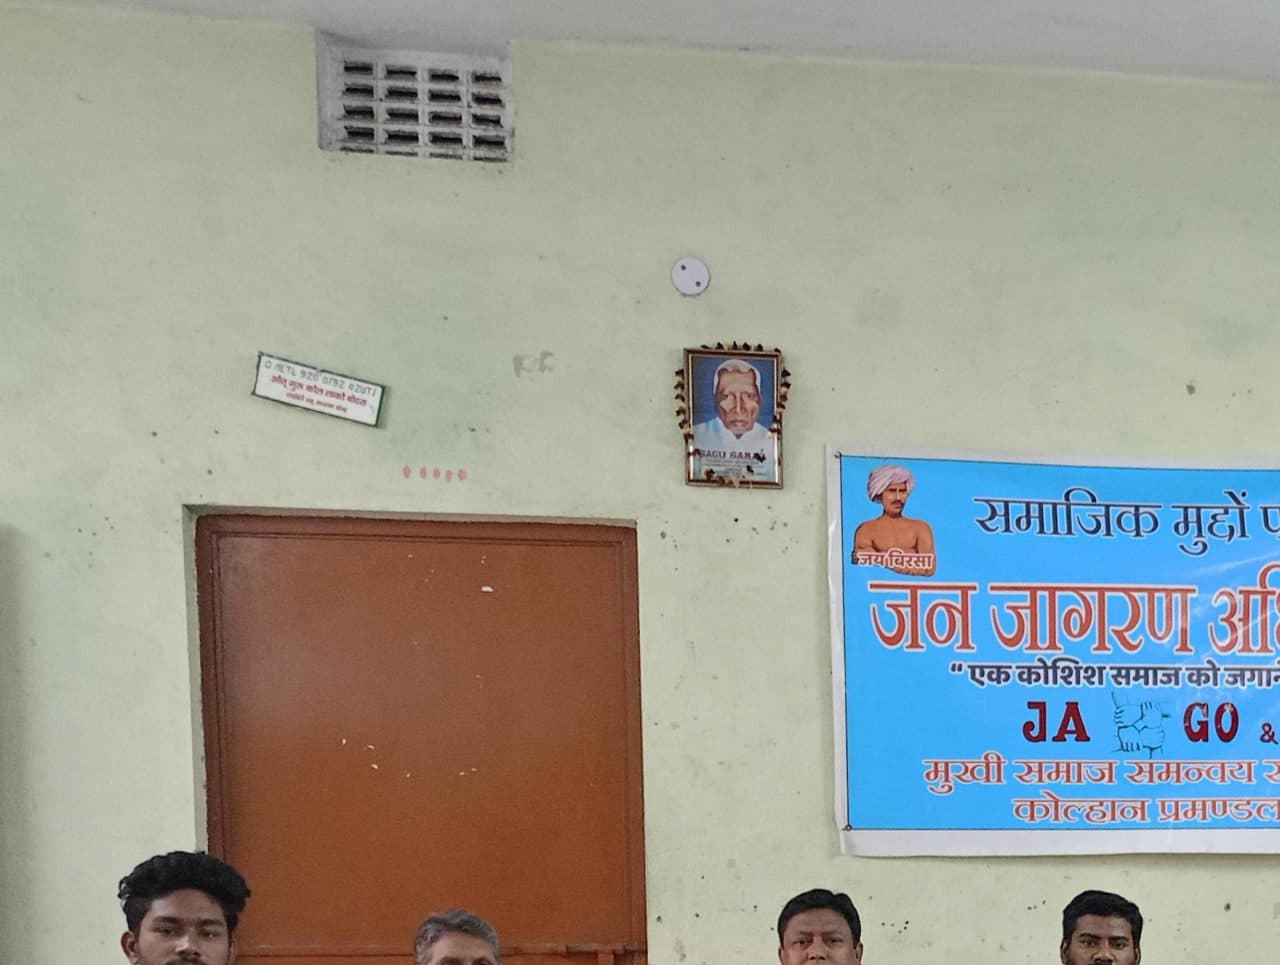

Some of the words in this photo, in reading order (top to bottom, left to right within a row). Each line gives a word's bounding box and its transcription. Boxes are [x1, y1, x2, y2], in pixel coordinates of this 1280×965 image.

[974, 487, 1162, 537] समाजिक
[1172, 490, 1250, 555] मुद्दों
[857, 552, 885, 567] जय
[869, 582, 977, 650] जन
[989, 583, 1196, 653] जागरण
[1016, 659, 1107, 687] कोशिश
[1110, 665, 1181, 687] समाज
[1184, 660, 1221, 687] को
[1022, 701, 1090, 742] JA
[1183, 702, 1240, 743] GO
[1260, 723, 1279, 744] &
[923, 752, 1007, 795] मुखी
[1013, 759, 1118, 785] समाज
[1124, 759, 1257, 785] समन्वय
[1013, 791, 1151, 823] कोल्हान
